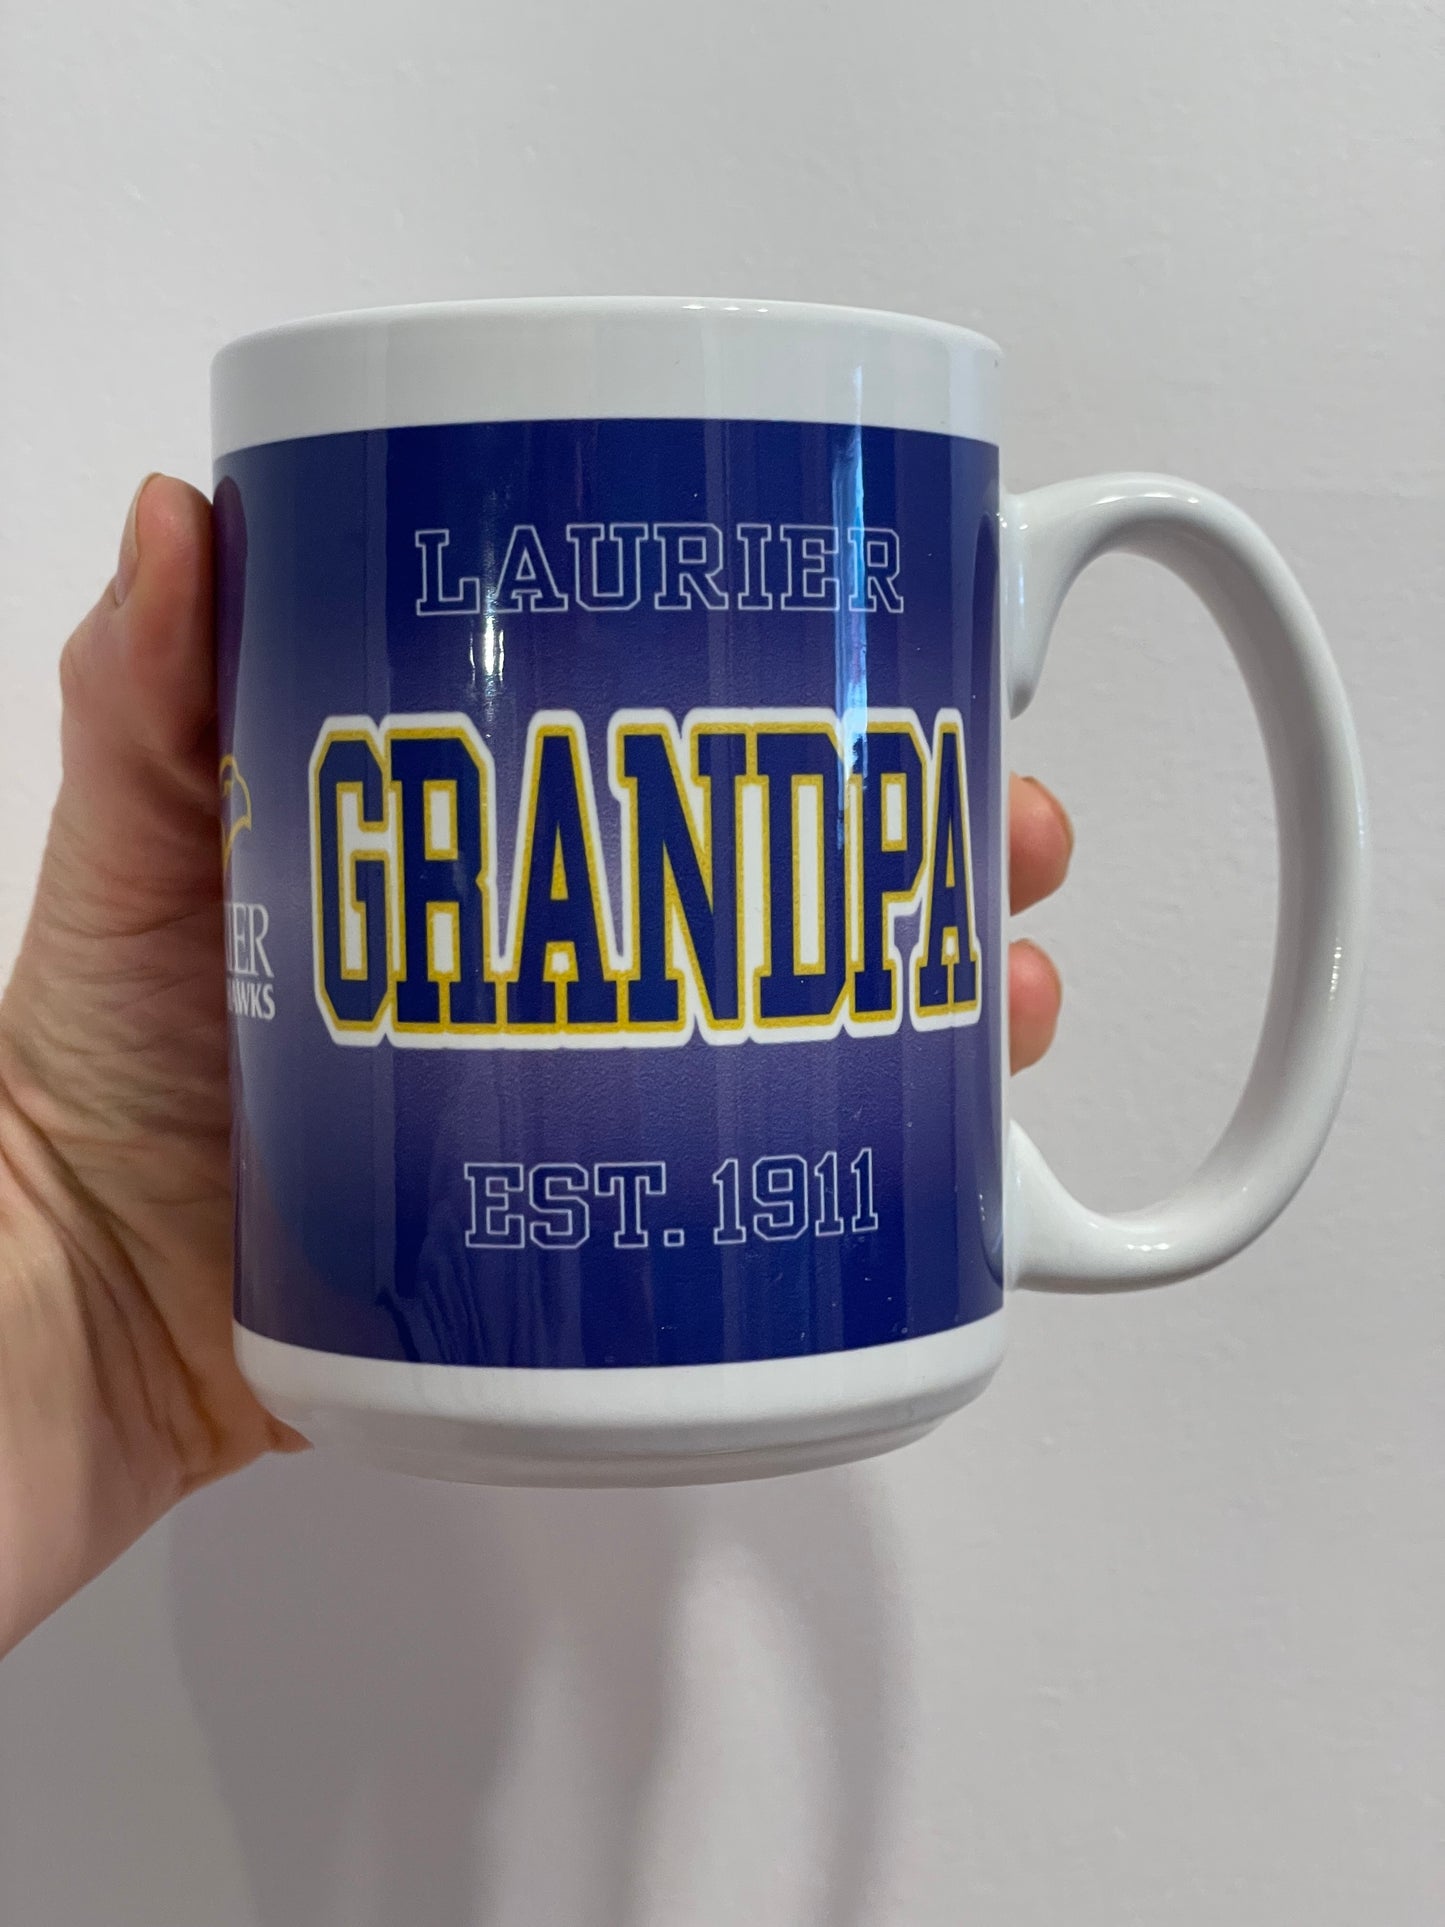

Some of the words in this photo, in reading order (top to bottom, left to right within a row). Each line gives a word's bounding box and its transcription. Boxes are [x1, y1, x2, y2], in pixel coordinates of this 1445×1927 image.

[415, 522, 904, 616] LAURIER
[309, 707, 982, 1049] GRANDPA
[464, 1161, 685, 1249] EST.
[712, 1147, 879, 1245] 1911
